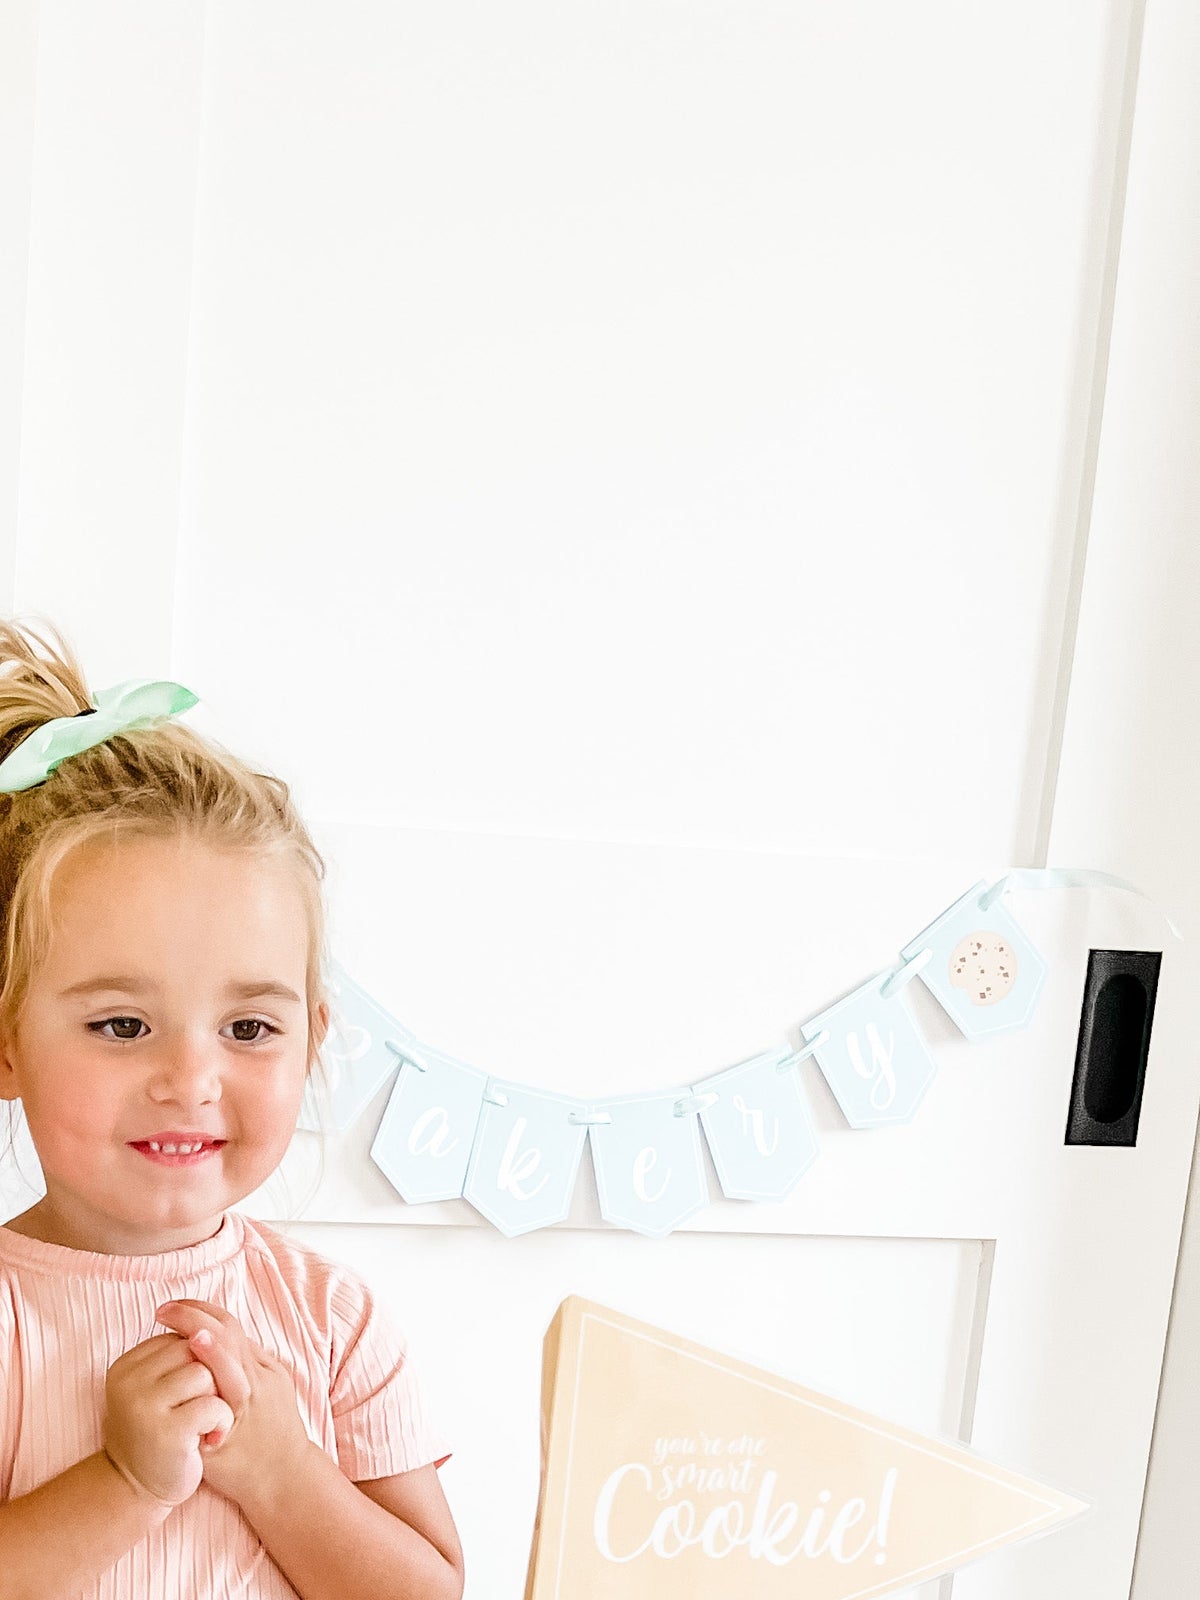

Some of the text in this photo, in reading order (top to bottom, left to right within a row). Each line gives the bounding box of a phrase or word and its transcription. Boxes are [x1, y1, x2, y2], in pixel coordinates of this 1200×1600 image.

[653, 1428, 769, 1465] you're one
[656, 1457, 758, 1501] smart
[593, 1462, 899, 1566] Cookie!
